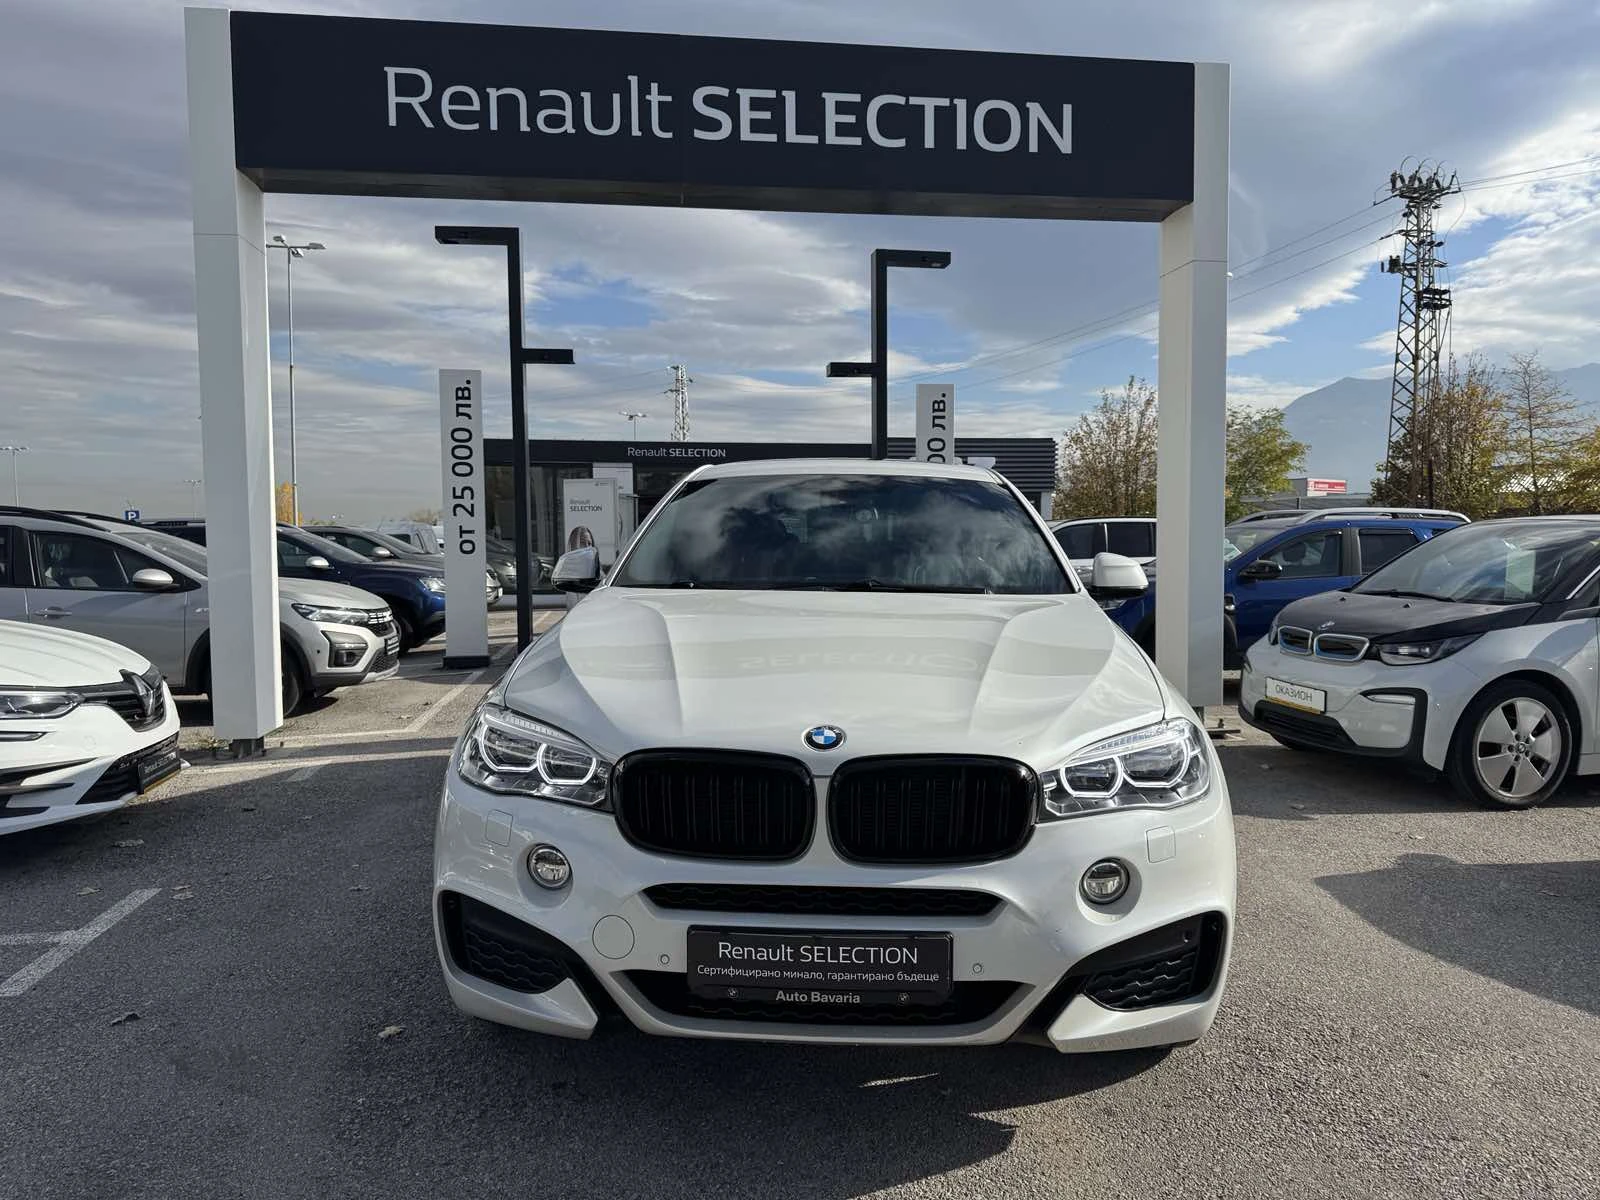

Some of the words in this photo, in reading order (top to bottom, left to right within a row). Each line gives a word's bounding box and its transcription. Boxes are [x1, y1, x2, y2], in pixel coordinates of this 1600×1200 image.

[384, 66, 673, 138] Renault
[692, 85, 1073, 154] SELECTION
[455, 379, 473, 420] лв.
[932, 393, 946, 430] лв.
[450, 427, 474, 478] 000
[627, 447, 667, 457] Renault
[669, 448, 726, 458] SELECTION
[452, 486, 475, 518] 25
[459, 525, 476, 555] от
[1275, 684, 1313, 702] ОКАЗИОН
[718, 941, 794, 962] Renault
[800, 945, 918, 964] SELECTION
[697, 964, 781, 979] Сертифицирано
[783, 971, 825, 981] минало,
[827, 972, 895, 983] гарантирано
[897, 971, 940, 983] бъдеще
[776, 990, 808, 1002] Auto
[810, 991, 861, 1004] Bavaria
